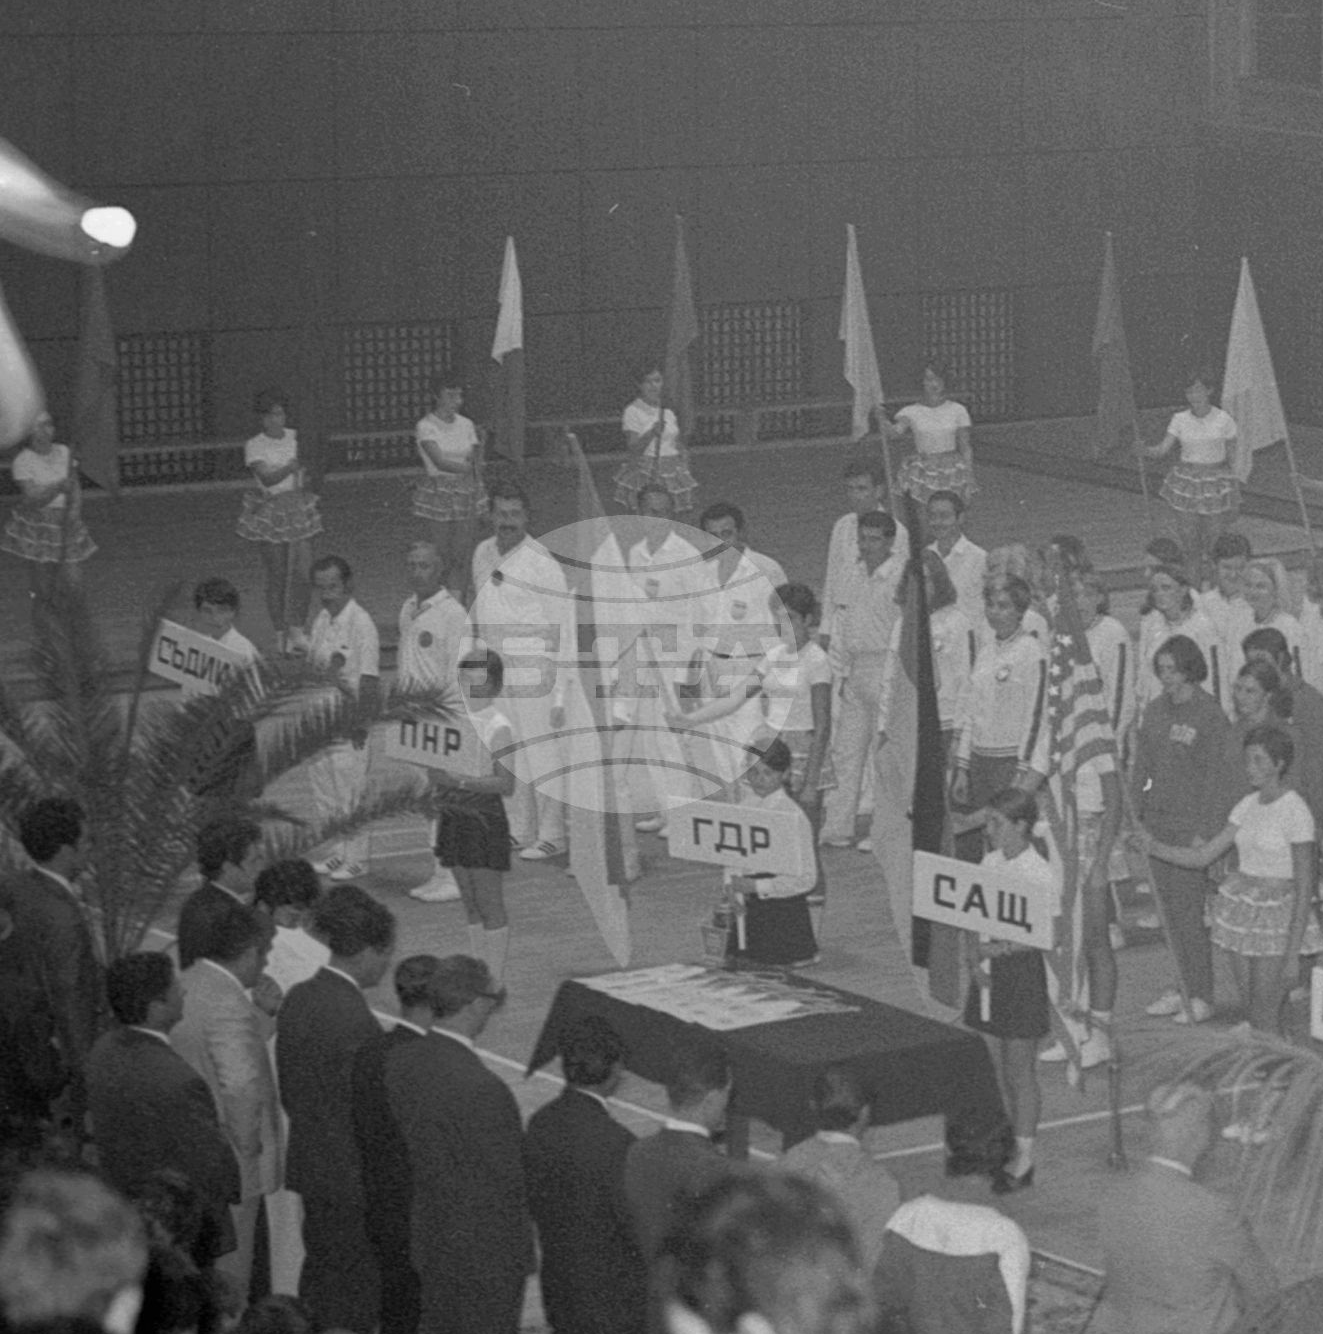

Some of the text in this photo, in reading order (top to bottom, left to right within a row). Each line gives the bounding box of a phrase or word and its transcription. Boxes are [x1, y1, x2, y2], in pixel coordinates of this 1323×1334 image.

[400, 719, 462, 757] ПНР
[692, 817, 771, 858] ГДР
[933, 873, 1033, 933] САЩ
